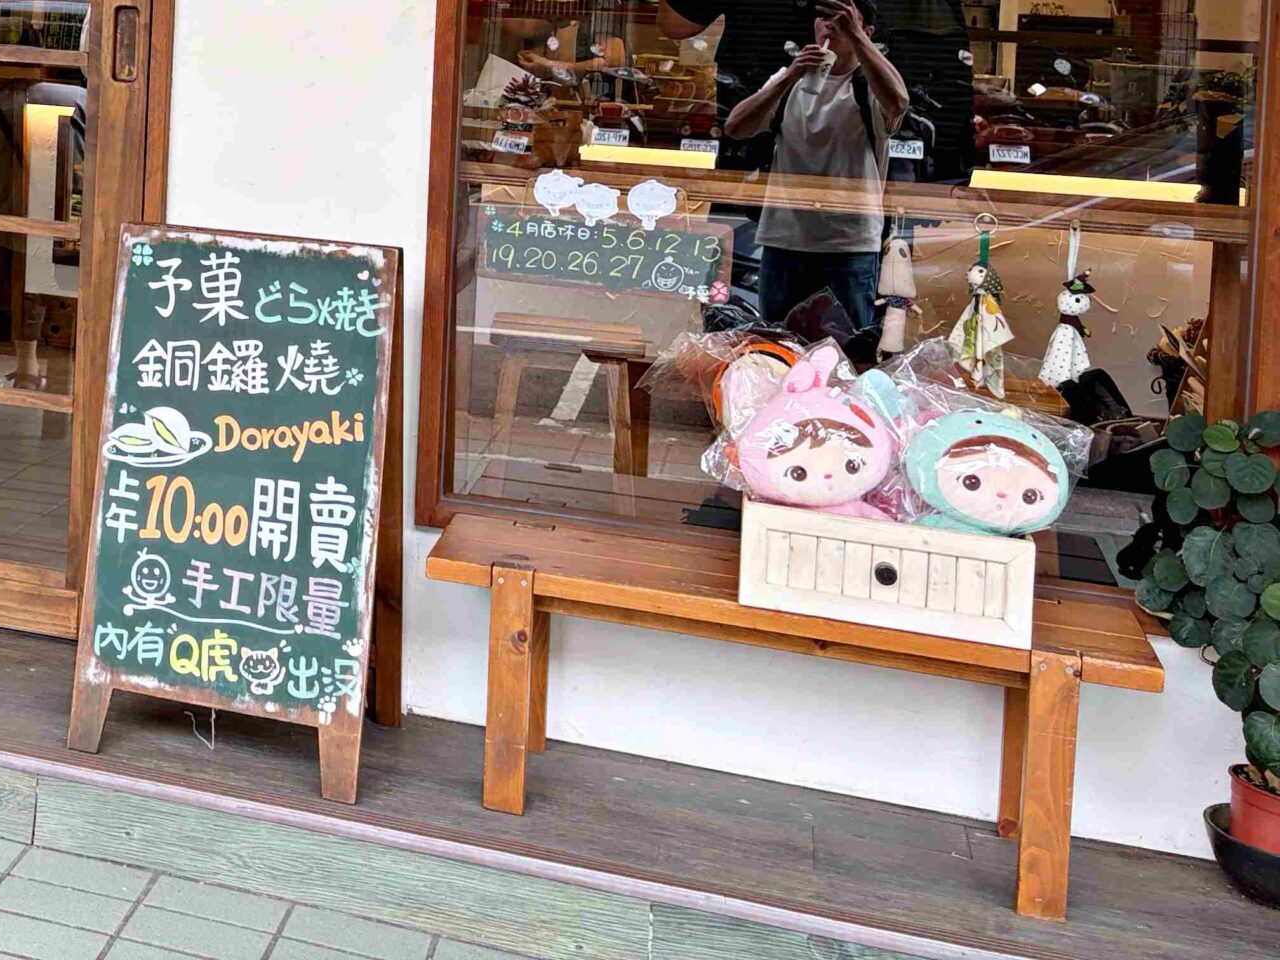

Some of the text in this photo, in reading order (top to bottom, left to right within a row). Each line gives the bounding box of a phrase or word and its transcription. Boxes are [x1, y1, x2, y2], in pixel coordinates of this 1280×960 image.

[148, 251, 390, 338] 予菓 どら焼き
[131, 338, 347, 396] 銅鑼燒
[213, 411, 365, 464] Dorayaki
[104, 469, 356, 573] 上午 10:00 開賣
[181, 559, 350, 640] 手工限量
